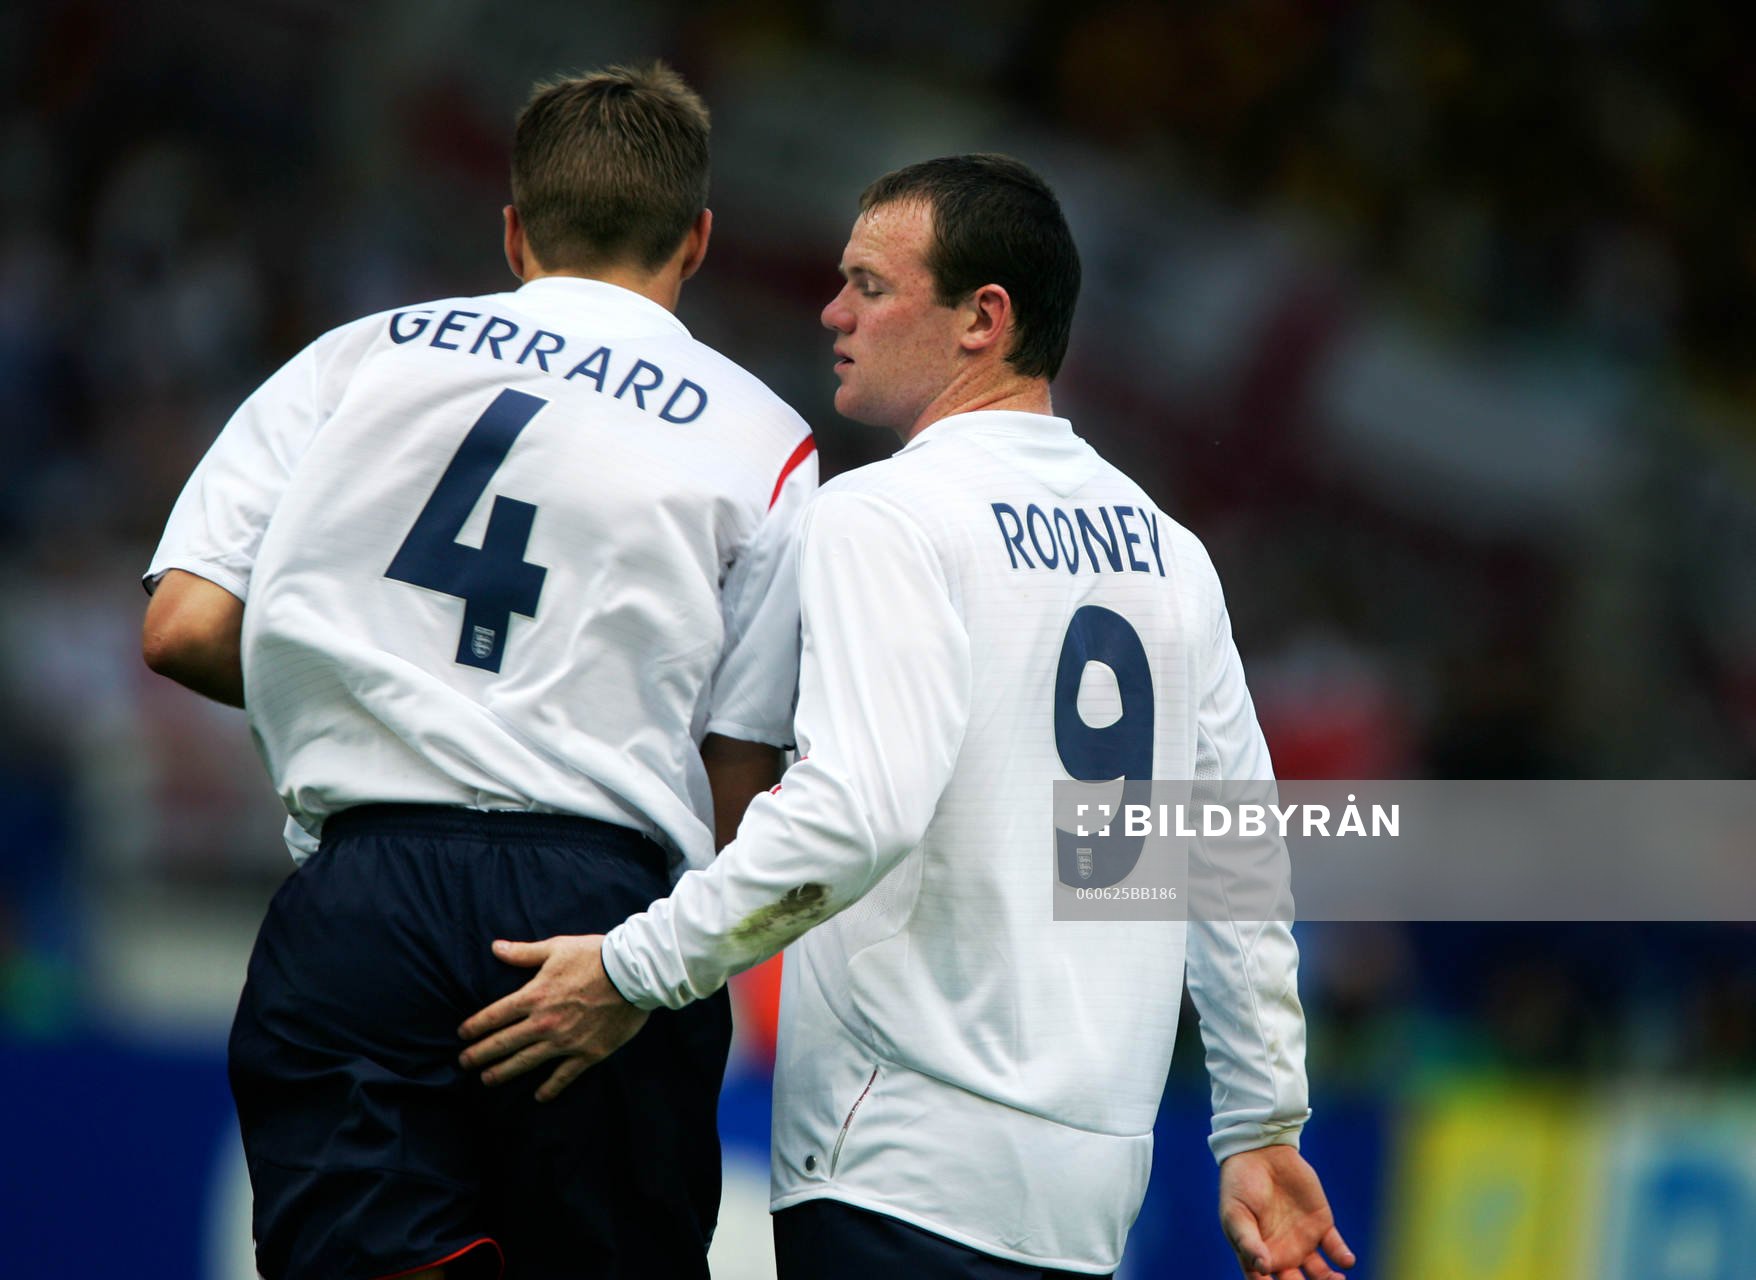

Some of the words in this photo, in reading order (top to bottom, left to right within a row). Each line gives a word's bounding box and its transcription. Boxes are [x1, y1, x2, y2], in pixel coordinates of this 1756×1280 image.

[389, 310, 708, 424] GERRARD
[384, 388, 549, 673] 4
[991, 503, 1166, 577] ROONEY
[1054, 604, 1154, 889] 9
